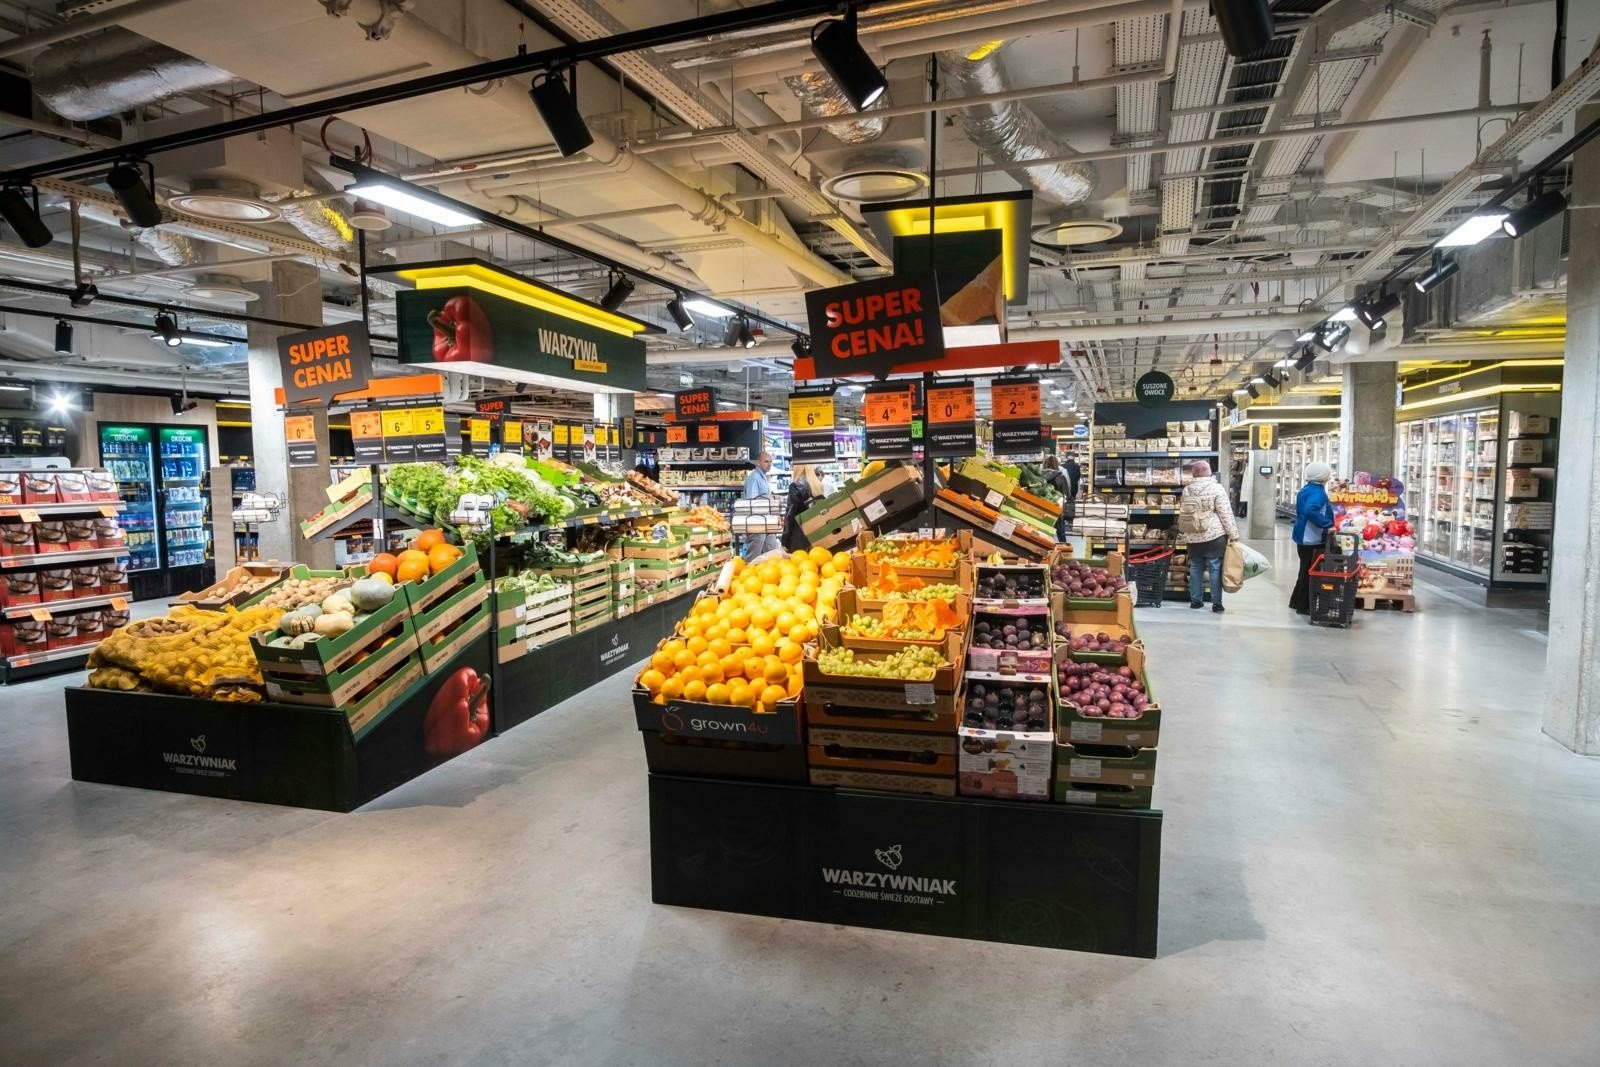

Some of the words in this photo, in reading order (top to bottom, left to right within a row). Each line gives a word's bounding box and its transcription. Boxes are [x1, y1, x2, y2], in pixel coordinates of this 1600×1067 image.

[825, 287, 924, 329] SUPER
[538, 328, 599, 363] WARZYWA
[831, 319, 925, 359] CENA!
[289, 335, 350, 366] SUPER
[293, 359, 353, 389] CENA!
[480, 400, 504, 412] SUPER
[680, 392, 710, 405] SUPER
[681, 403, 710, 415] CENA!
[881, 409, 890, 421] 4
[945, 404, 953, 418] 0
[1009, 401, 1017, 415] 2
[807, 413, 815, 425] 6
[162, 752, 237, 770] WARZYWNIAK
[822, 867, 957, 895] WARZYWNIAK
[843, 888, 879, 900] CODZIENNIE
[903, 894, 934, 905] DOSTAWY
